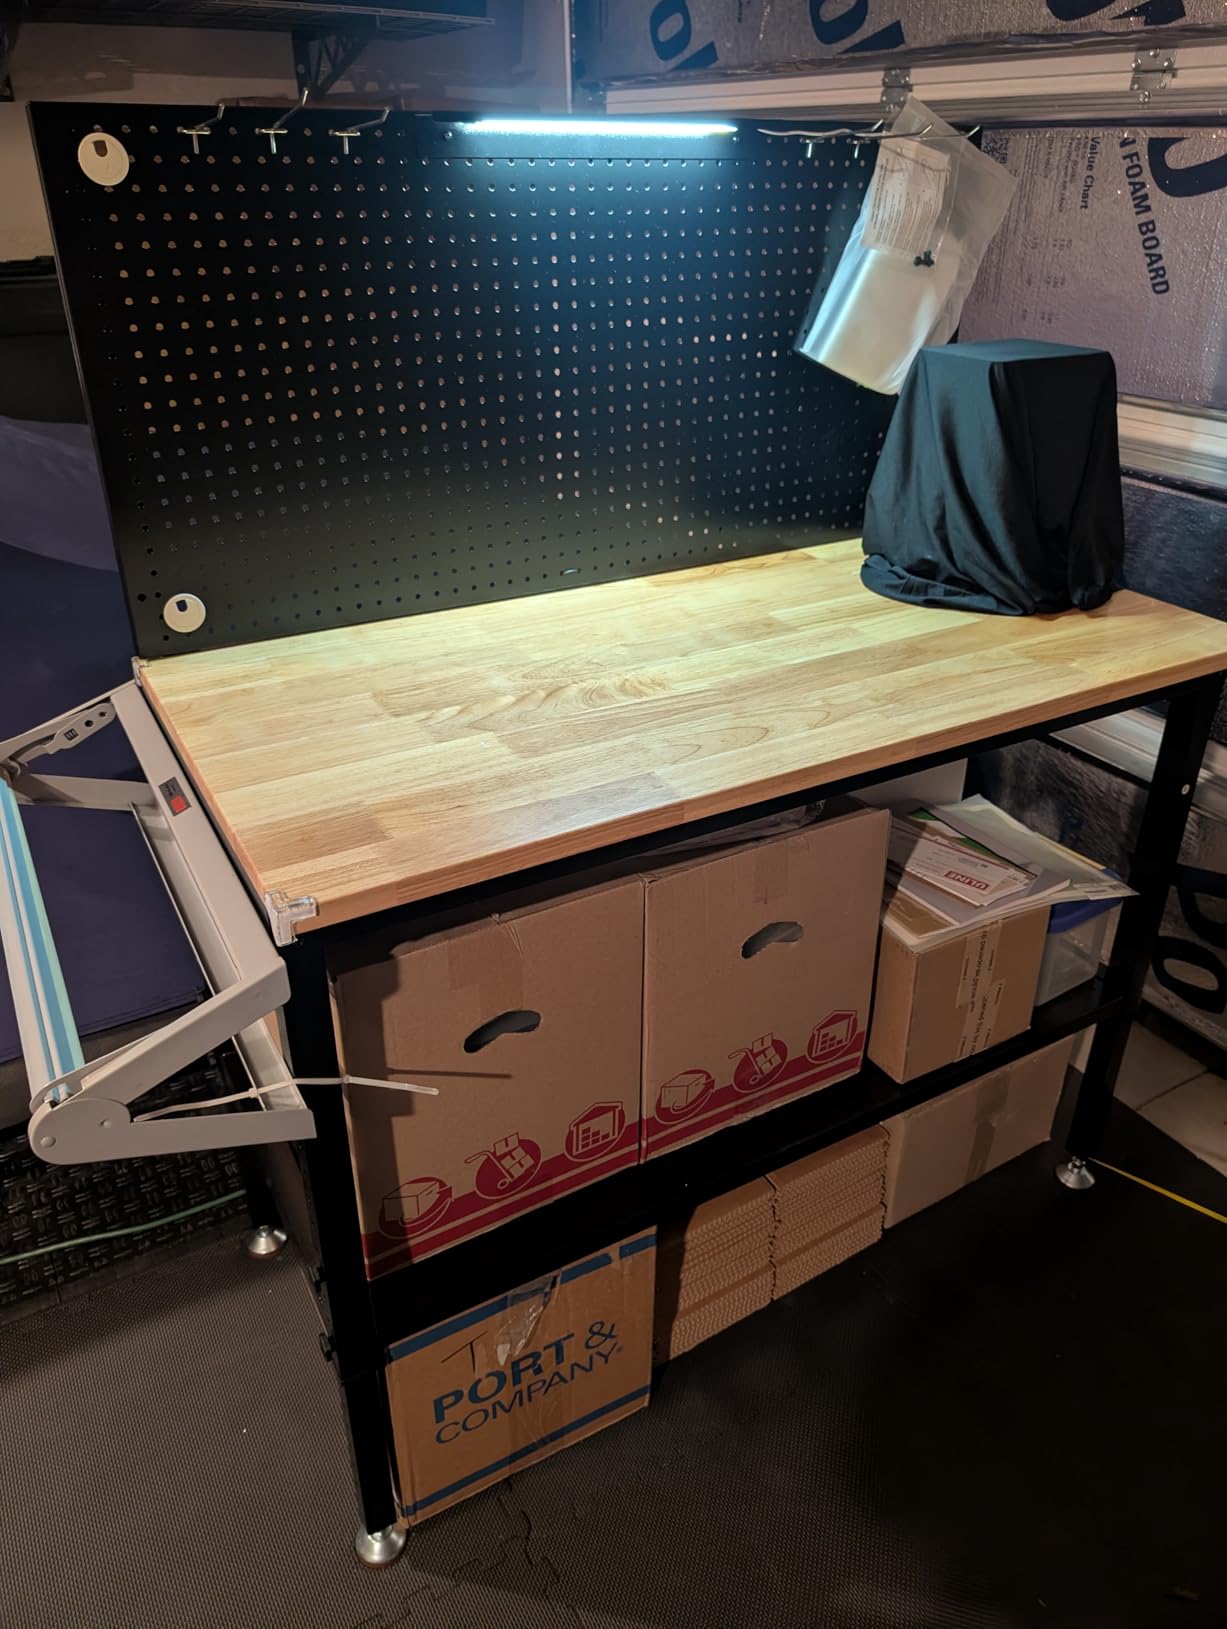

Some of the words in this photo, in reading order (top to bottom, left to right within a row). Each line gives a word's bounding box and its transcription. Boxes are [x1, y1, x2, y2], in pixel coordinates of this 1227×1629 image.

[1086, 136, 1101, 171] Value
[1080, 175, 1095, 209] Chart
[1122, 152, 1152, 216] FOAM
[1138, 220, 1170, 295] BOARD
[945, 871, 988, 890] ULINE
[433, 1333, 575, 1423] PORT
[585, 1321, 617, 1349] &
[435, 1342, 619, 1444] COMPANY
